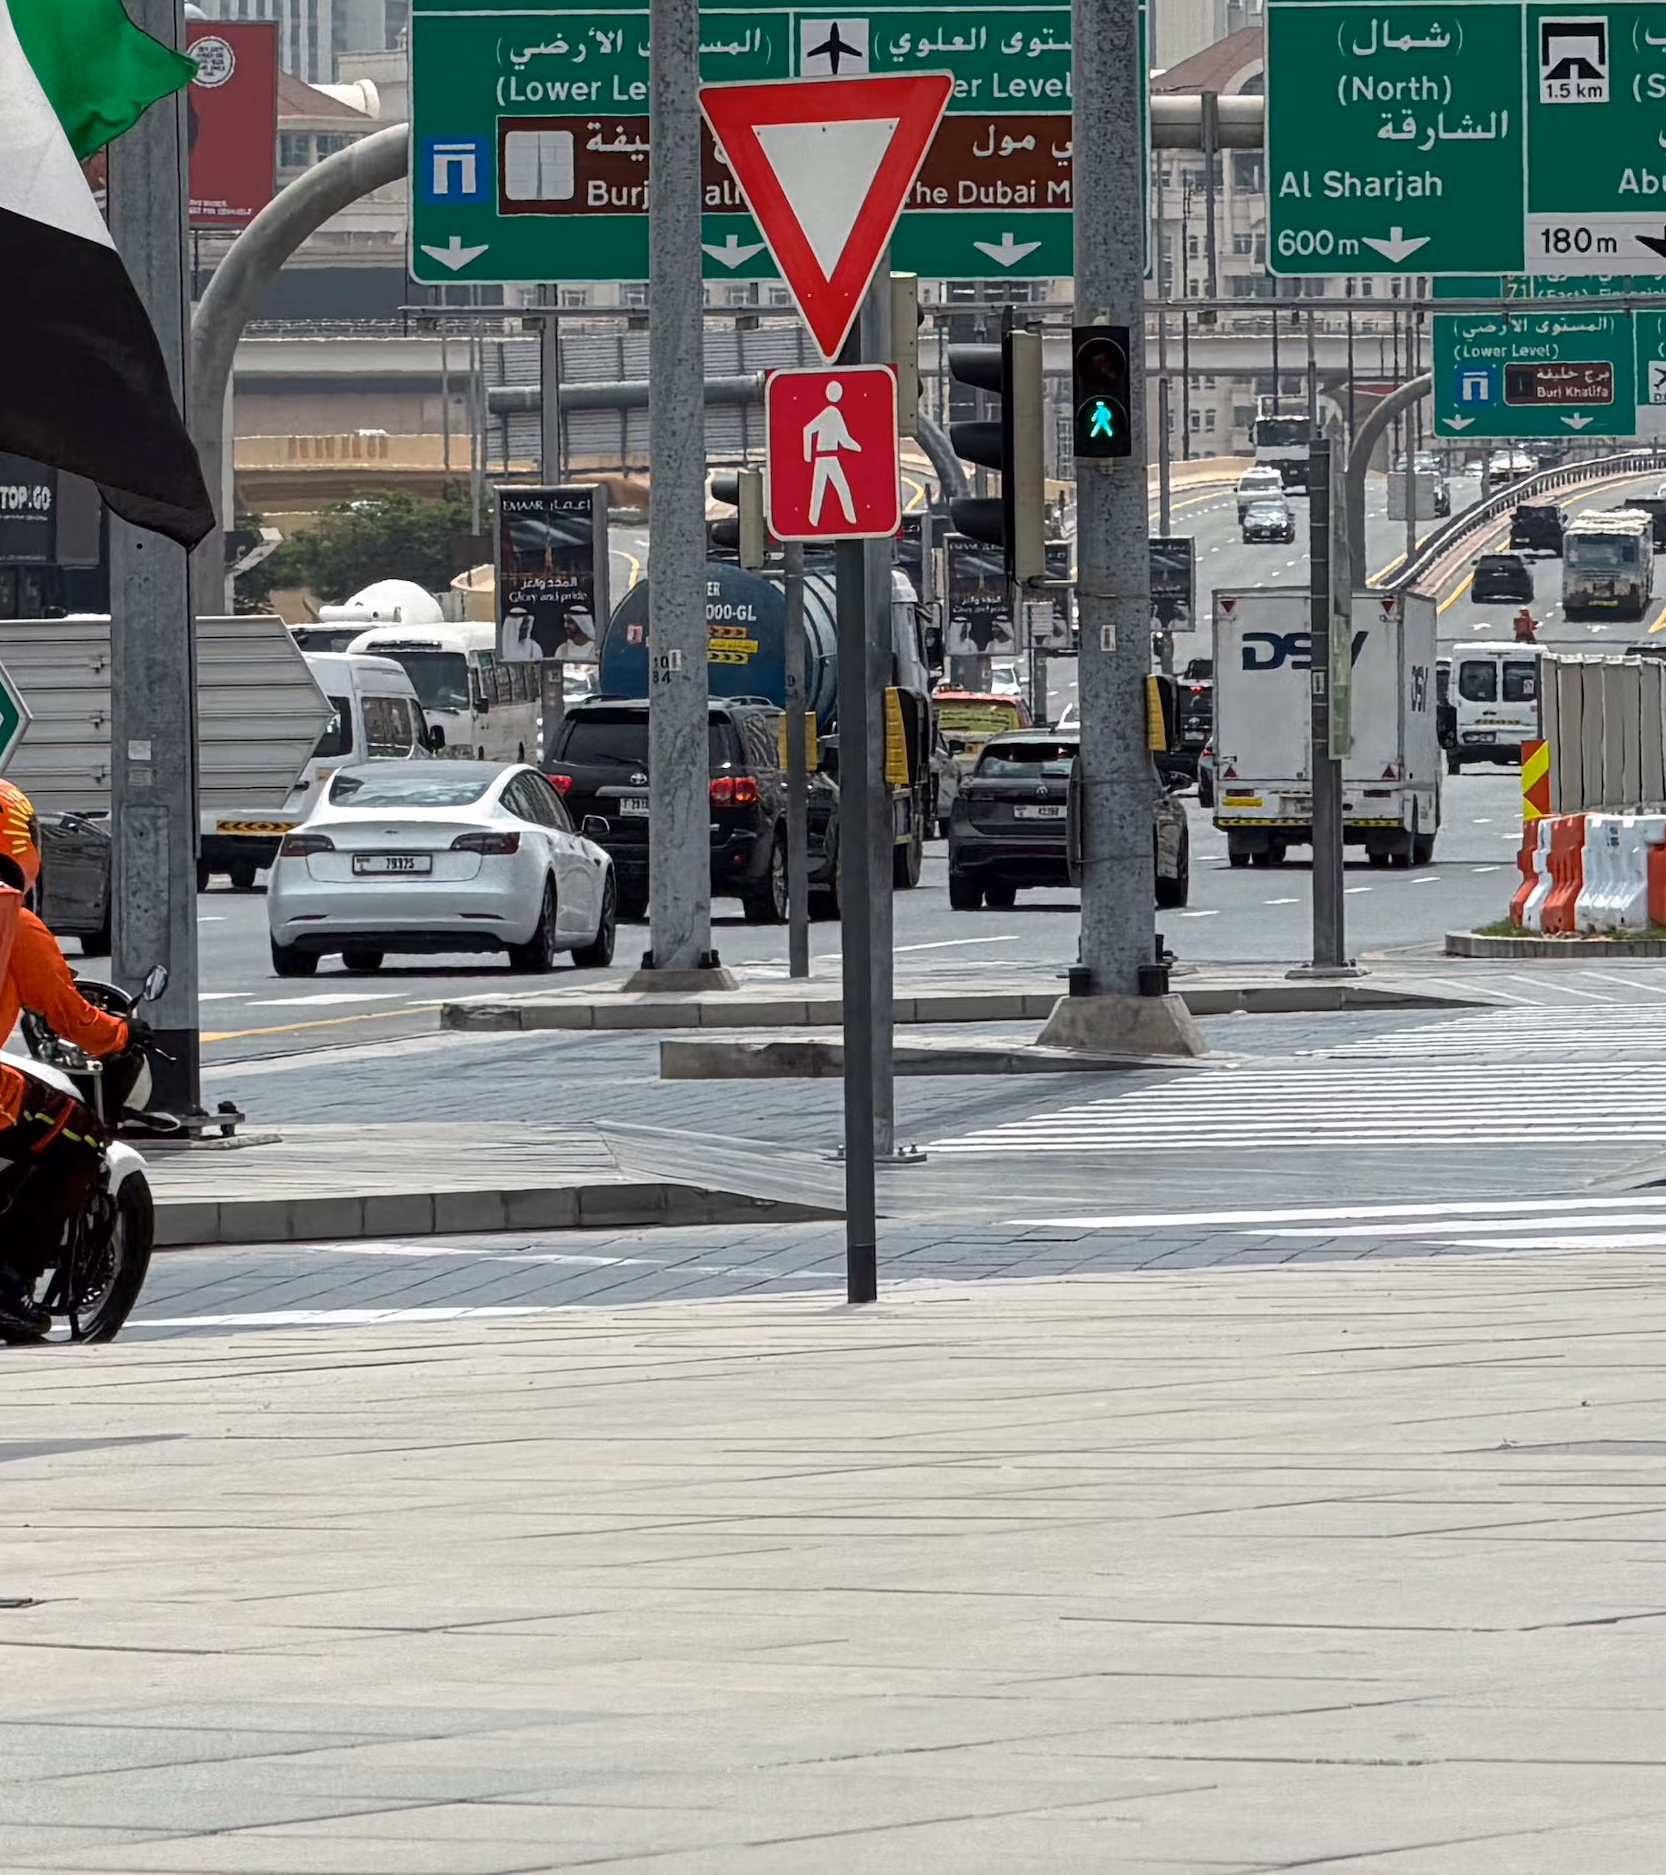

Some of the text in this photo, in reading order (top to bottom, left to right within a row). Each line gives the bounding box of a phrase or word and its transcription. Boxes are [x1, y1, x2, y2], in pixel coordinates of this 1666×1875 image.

[1336, 17, 1465, 57] (شمال)
[1337, 75, 1453, 106] (North)
[1545, 82, 1603, 99] 1.5 km
[971, 124, 1037, 158] مول
[1376, 109, 1509, 152] الشارقة
[907, 180, 949, 205] he
[957, 179, 1037, 205] Dubai
[1278, 169, 1444, 202] Al Sharjah
[1277, 229, 1359, 257] 600 m
[1541, 228, 1618, 254] 180 m
[1453, 343, 1560, 359] (Lower Level)
[1564, 385, 1609, 398] Khalifa
